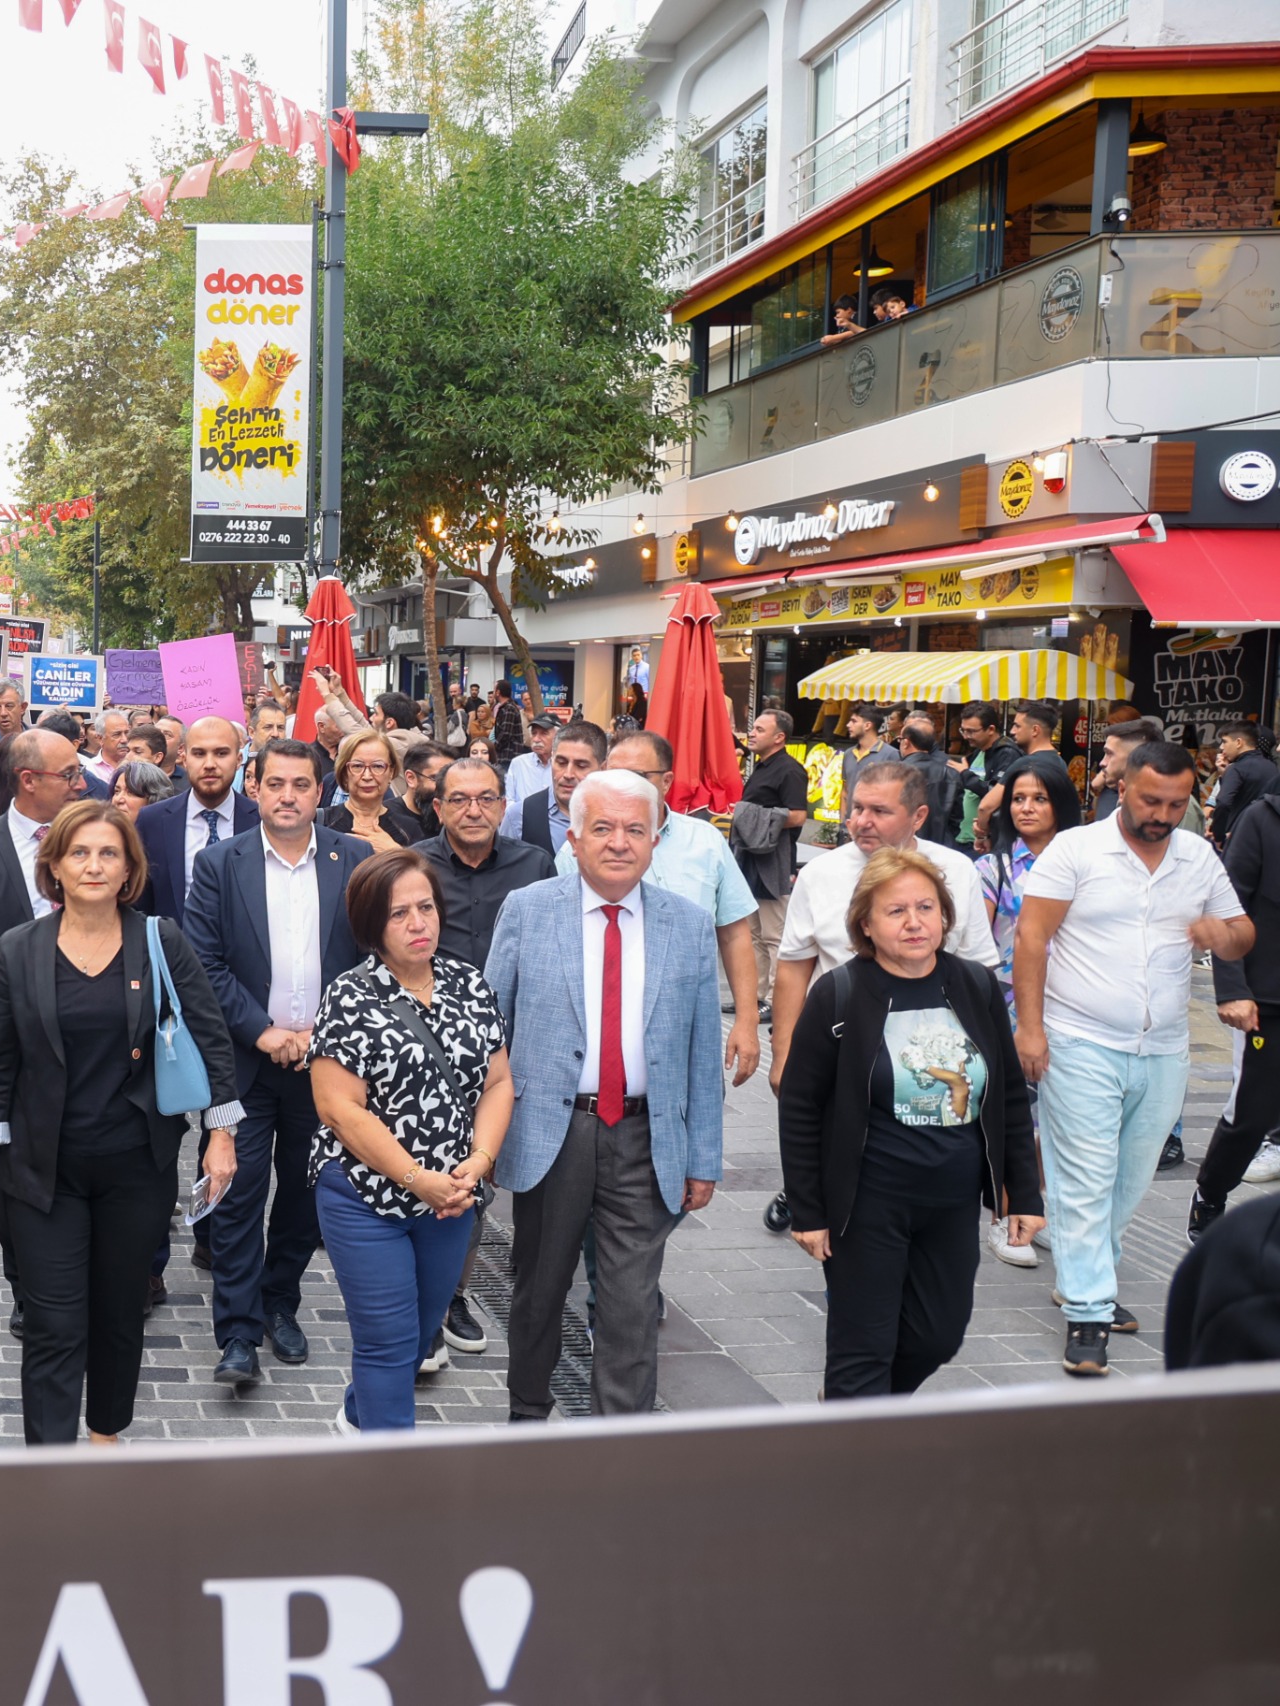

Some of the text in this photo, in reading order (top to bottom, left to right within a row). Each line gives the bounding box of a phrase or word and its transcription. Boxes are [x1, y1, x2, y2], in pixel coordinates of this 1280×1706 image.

[204, 268, 304, 295] donas
[207, 299, 301, 325] döner
[209, 424, 284, 442] En Lezzetli
[226, 520, 272, 531] 444 33 67
[758, 500, 895, 552] Maydonoz Döner
[199, 532, 222, 542] 0276
[224, 533, 241, 543] 222
[243, 533, 255, 543] 22
[257, 534, 269, 544] 30
[278, 534, 290, 544] 40
[939, 571, 961, 588] MAY
[937, 591, 962, 607] TAKO
[854, 602, 869, 615] DER
[9, 642, 29, 652] ADIN
[1154, 647, 1243, 683] MAY
[36, 669, 91, 681] CANİLER
[42, 686, 84, 698] KADIN
[1154, 676, 1243, 708] TAKO
[894, 1103, 910, 1114] SO
[895, 1115, 941, 1126] ITUDE.
